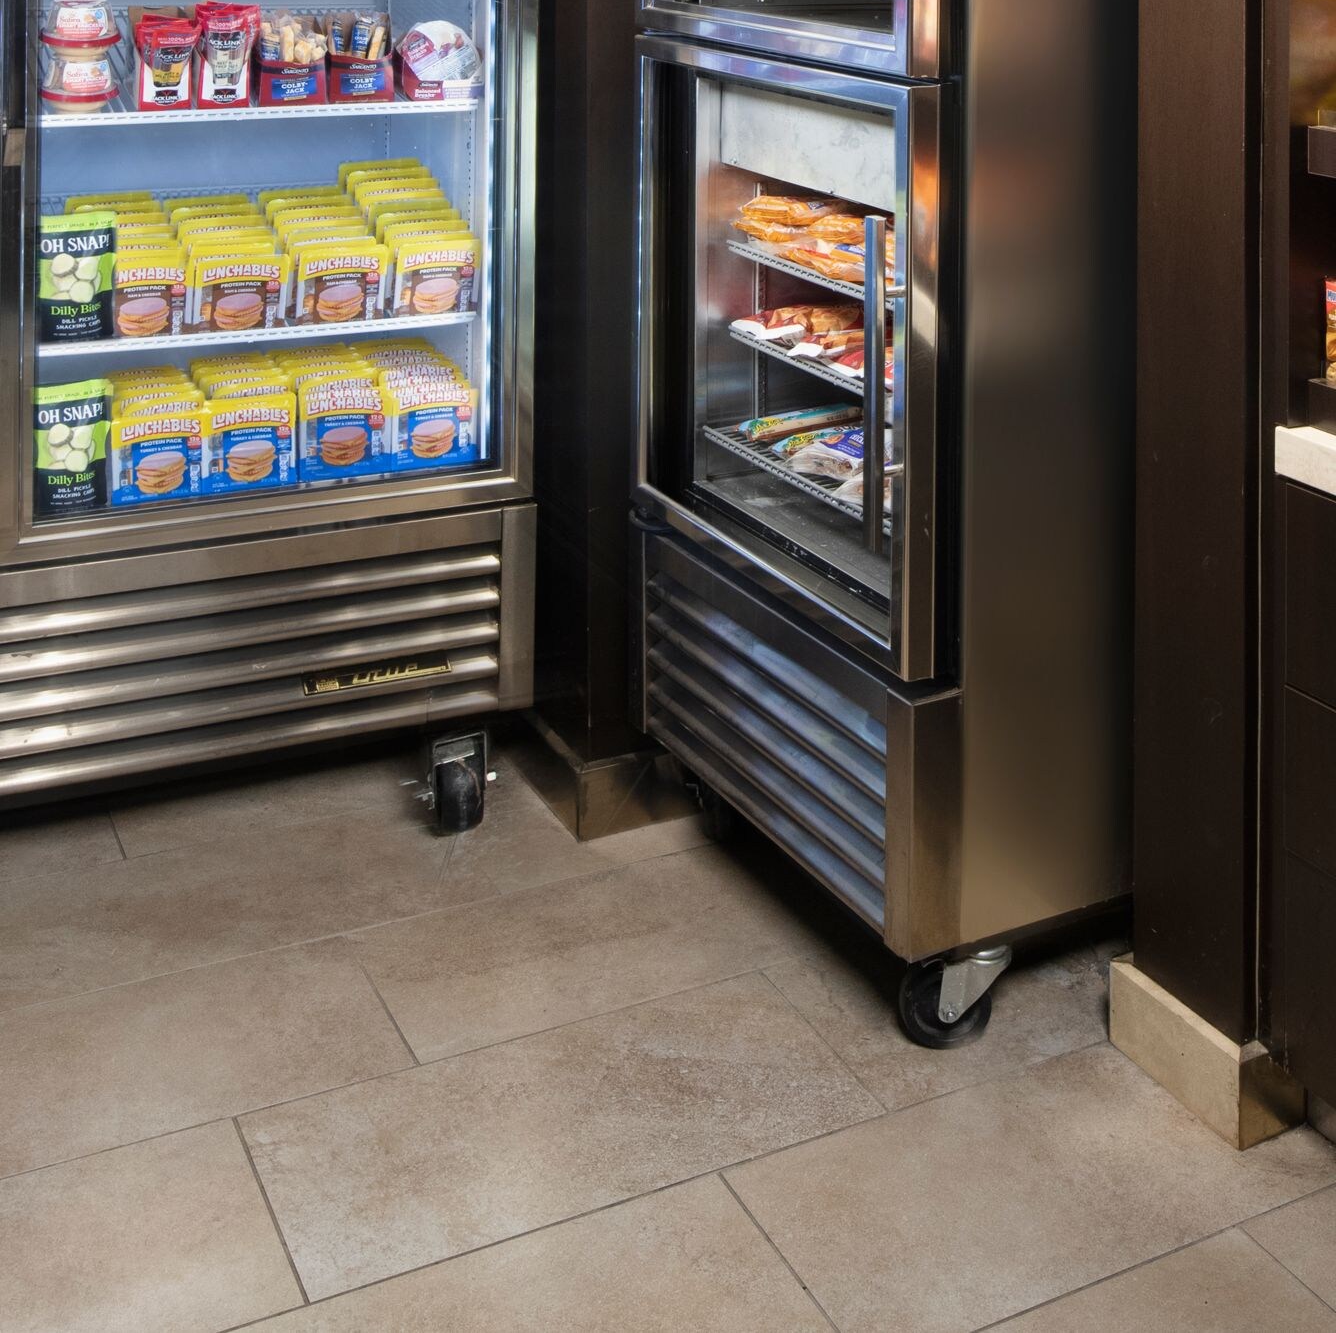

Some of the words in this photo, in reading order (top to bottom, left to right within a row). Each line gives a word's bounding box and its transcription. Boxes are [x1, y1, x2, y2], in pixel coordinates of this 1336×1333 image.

[41, 239, 64, 253] OH
[67, 234, 110, 252] SNAP!
[305, 256, 380, 276] LUNCHABLES
[403, 250, 475, 269] LUNCHABLES
[117, 267, 186, 283] NCHABLES
[203, 264, 280, 283] LUNCHABLES
[51, 306, 78, 317] Dilly
[56, 322, 86, 330] SNACKING
[307, 397, 383, 415] LUNCHABLES
[400, 390, 470, 410] LUNCHABLES
[38, 409, 60, 424] OH
[63, 402, 103, 422] SNAP!
[212, 408, 290, 429] LUNCHABLES
[121, 418, 200, 442] LUNCHABLES
[230, 428, 255, 436] PROTEIN
[47, 475, 73, 487] Dilly
[52, 491, 80, 499] SNACKING
